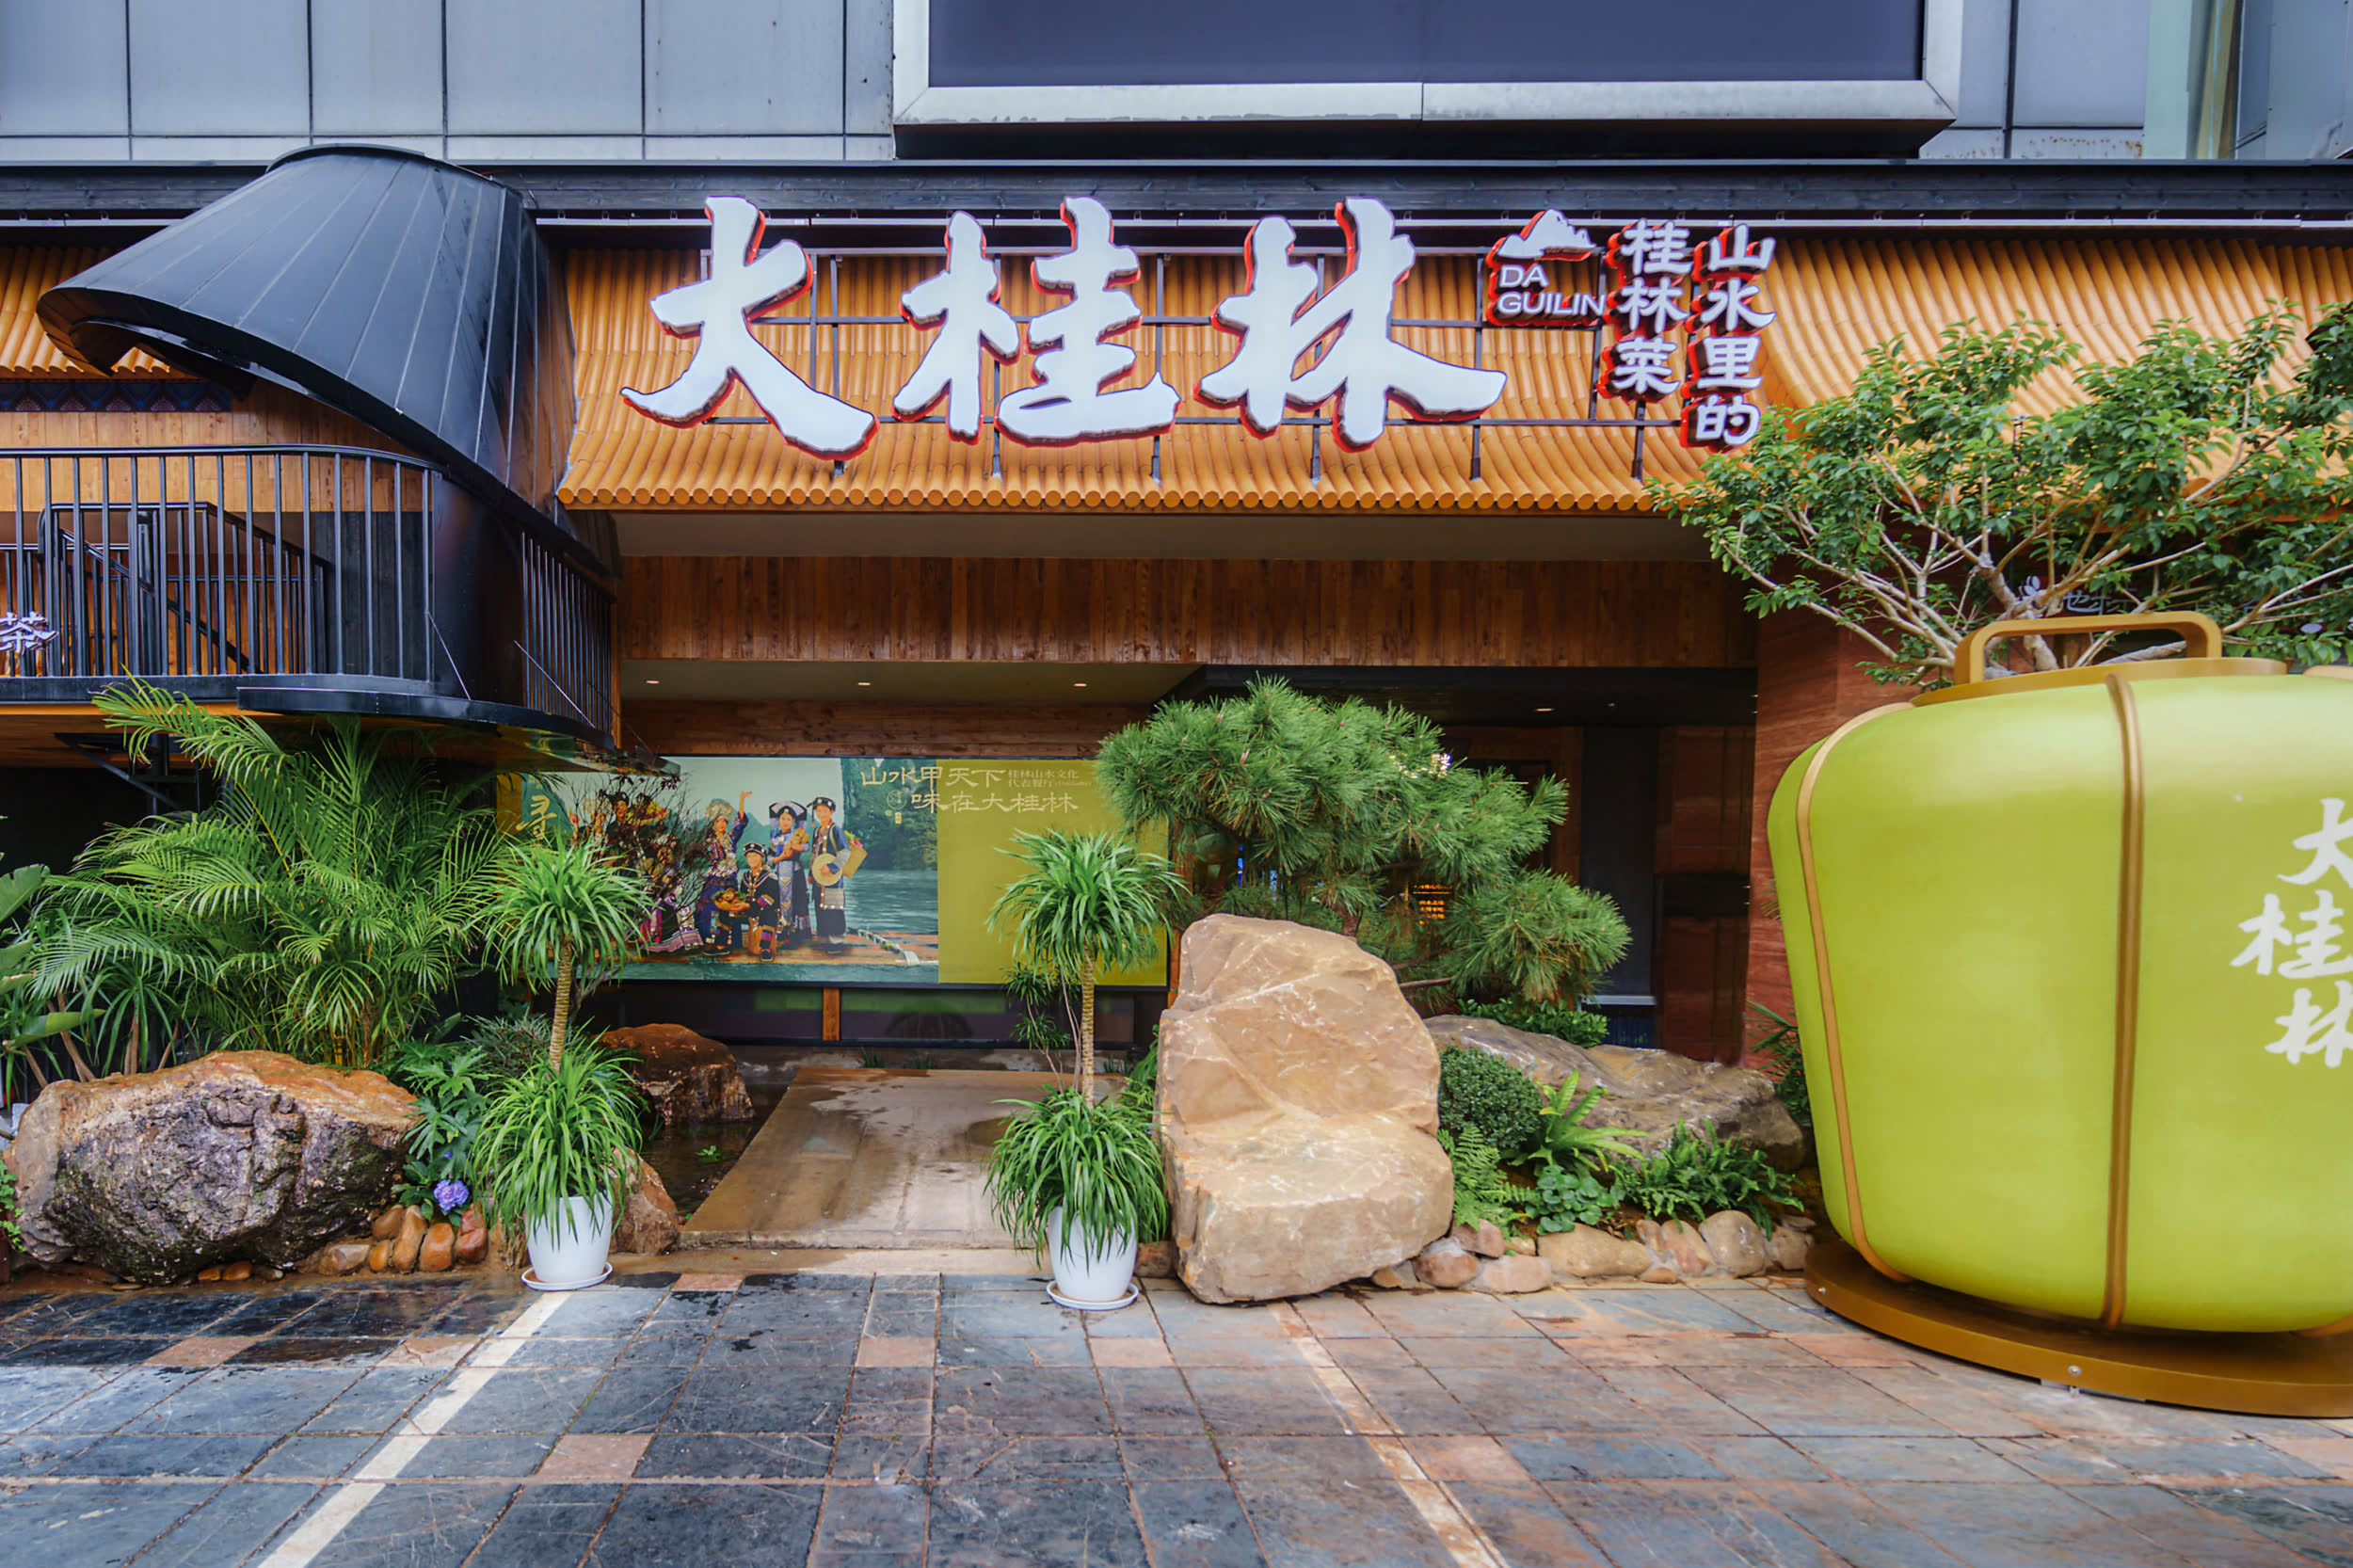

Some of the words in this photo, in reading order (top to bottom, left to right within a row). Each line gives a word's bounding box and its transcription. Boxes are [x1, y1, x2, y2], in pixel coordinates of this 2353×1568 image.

[1497, 291, 1606, 318] GUILIN
[1498, 264, 1549, 288] DA
[1611, 218, 1693, 396] 桂林菜
[621, 196, 1507, 460] 大桂林
[1695, 223, 1777, 446] 山水里的
[860, 766, 1006, 791] 山水甲天下
[910, 791, 1080, 814] 味在大桂林
[2229, 797, 2353, 1069] 大桂林
